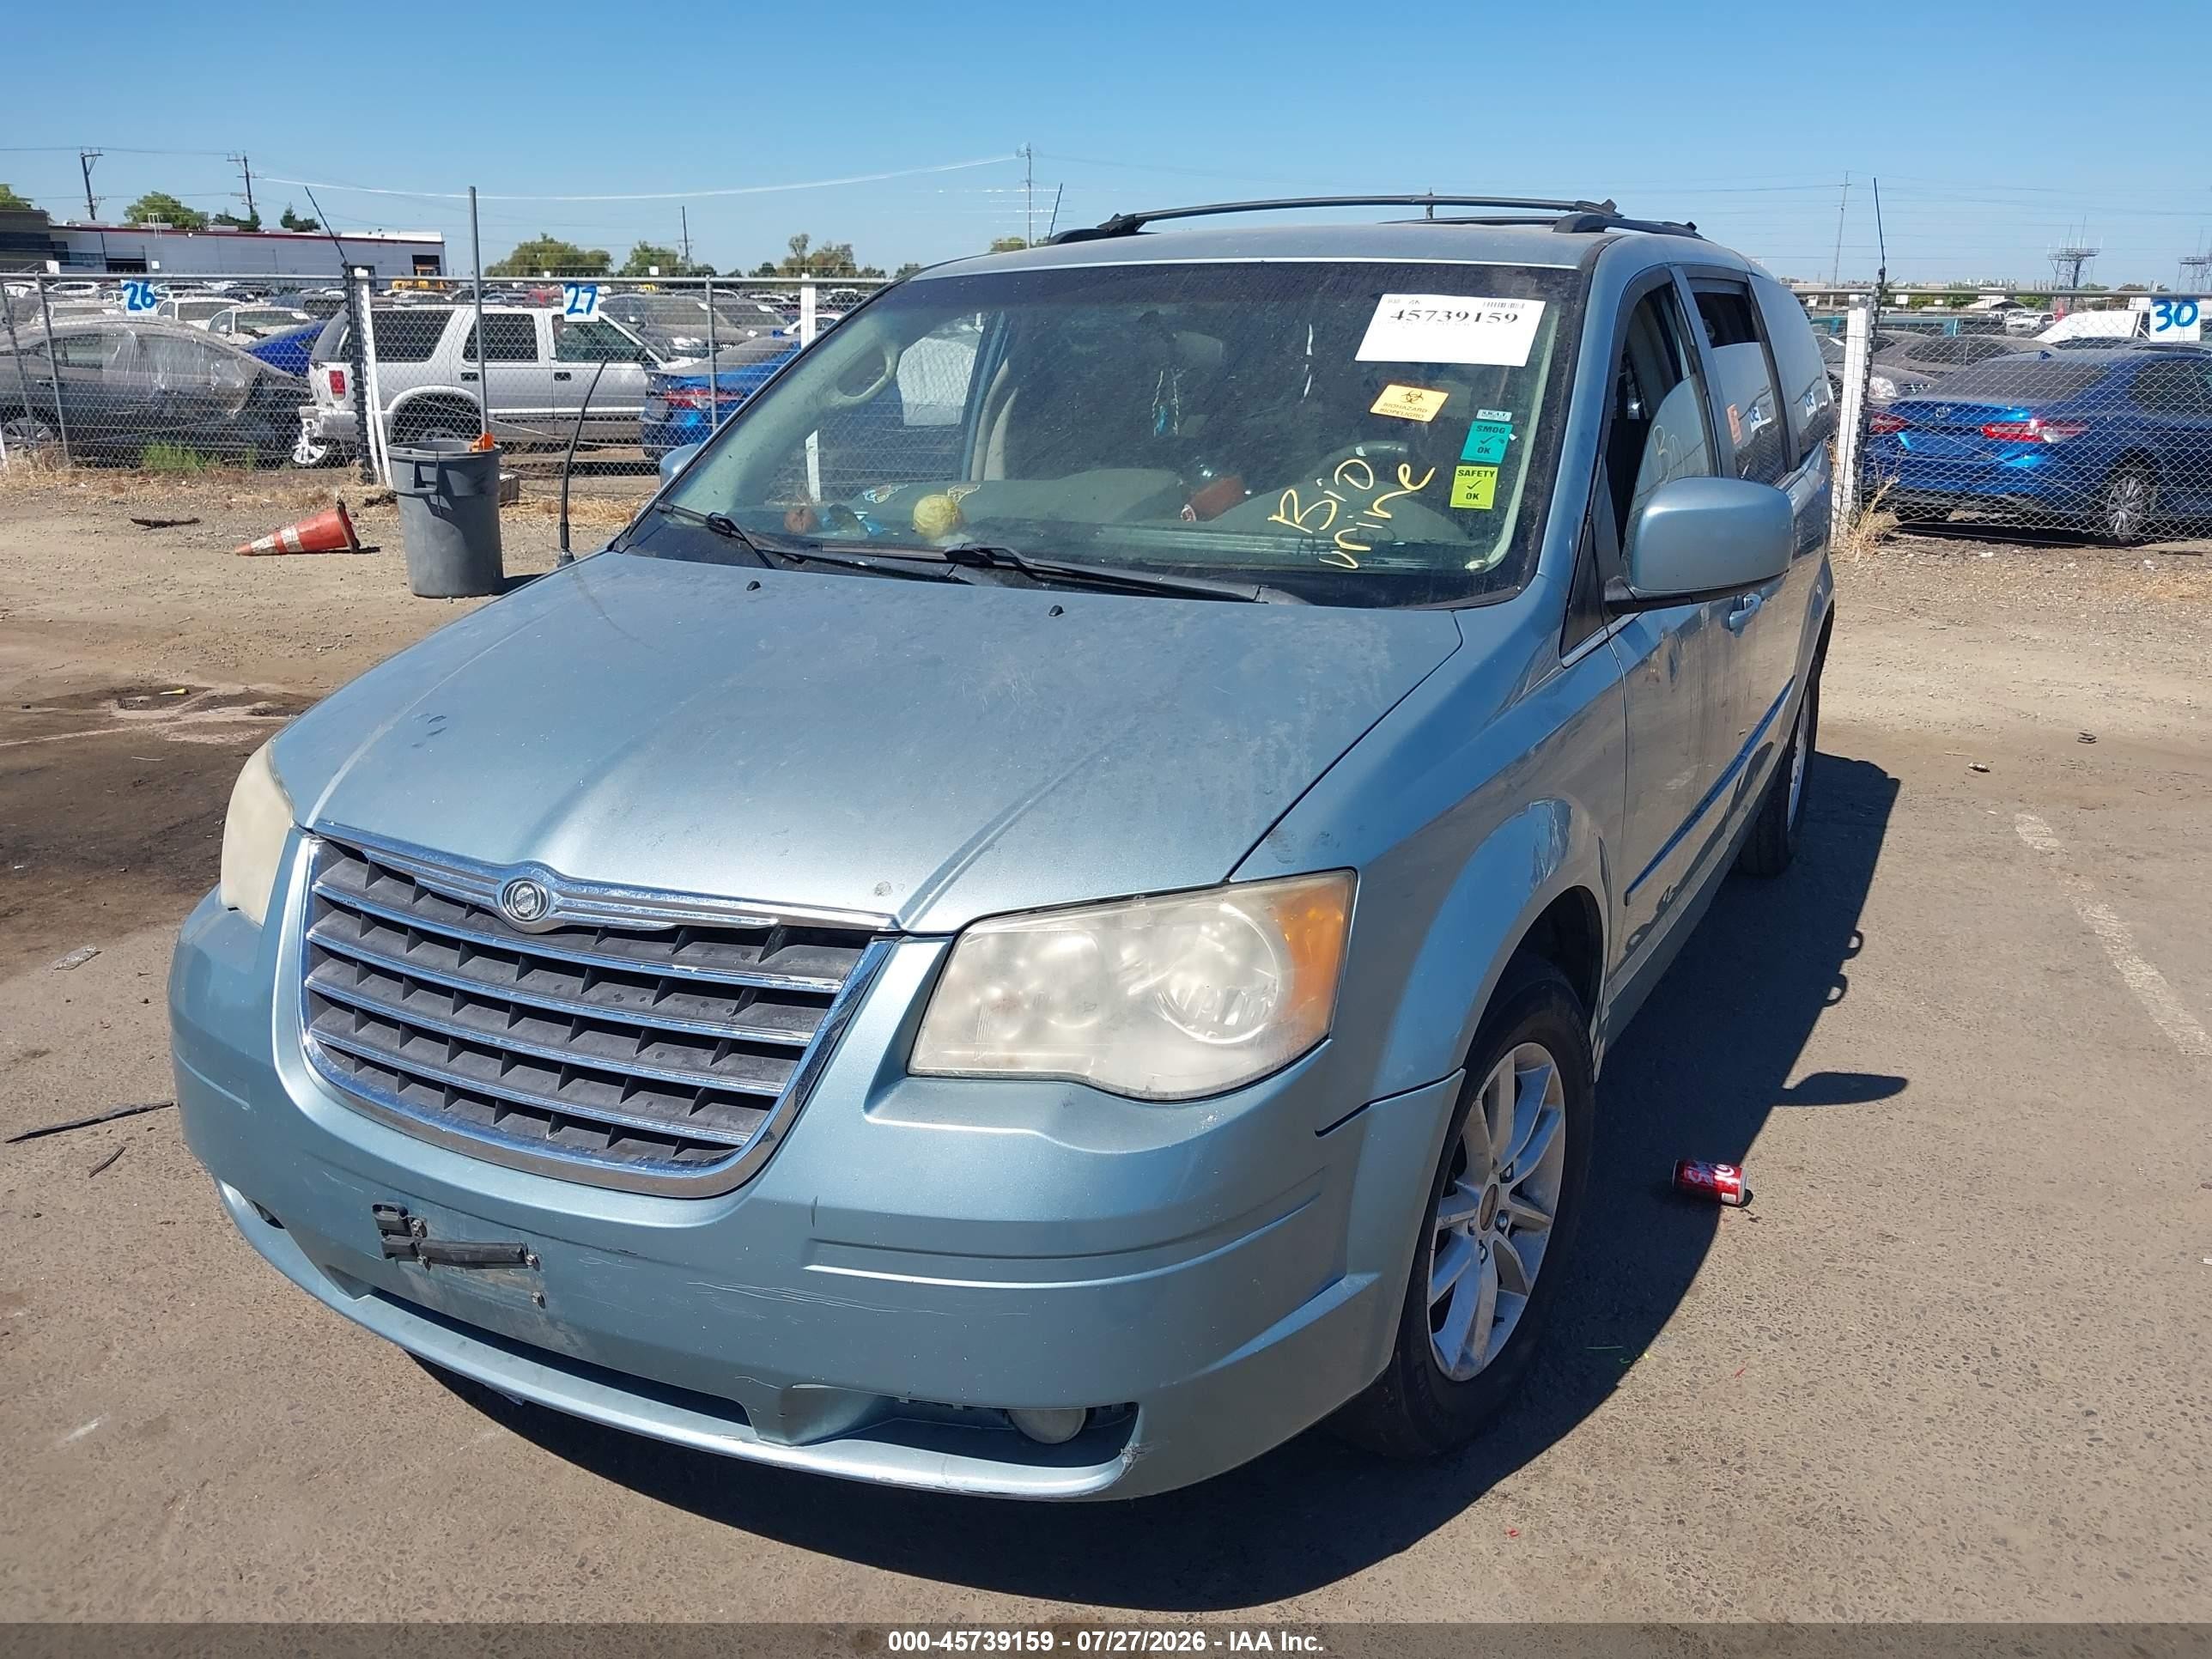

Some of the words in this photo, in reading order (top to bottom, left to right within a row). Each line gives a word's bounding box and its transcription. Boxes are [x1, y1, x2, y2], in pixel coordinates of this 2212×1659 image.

[123, 281, 155, 310] 26
[565, 283, 597, 315] 27
[1389, 308, 1519, 324] 45739159
[2152, 300, 2198, 331] 30
[1383, 402, 1428, 413] BIOHAZARD
[1476, 425, 1506, 434] SMOG
